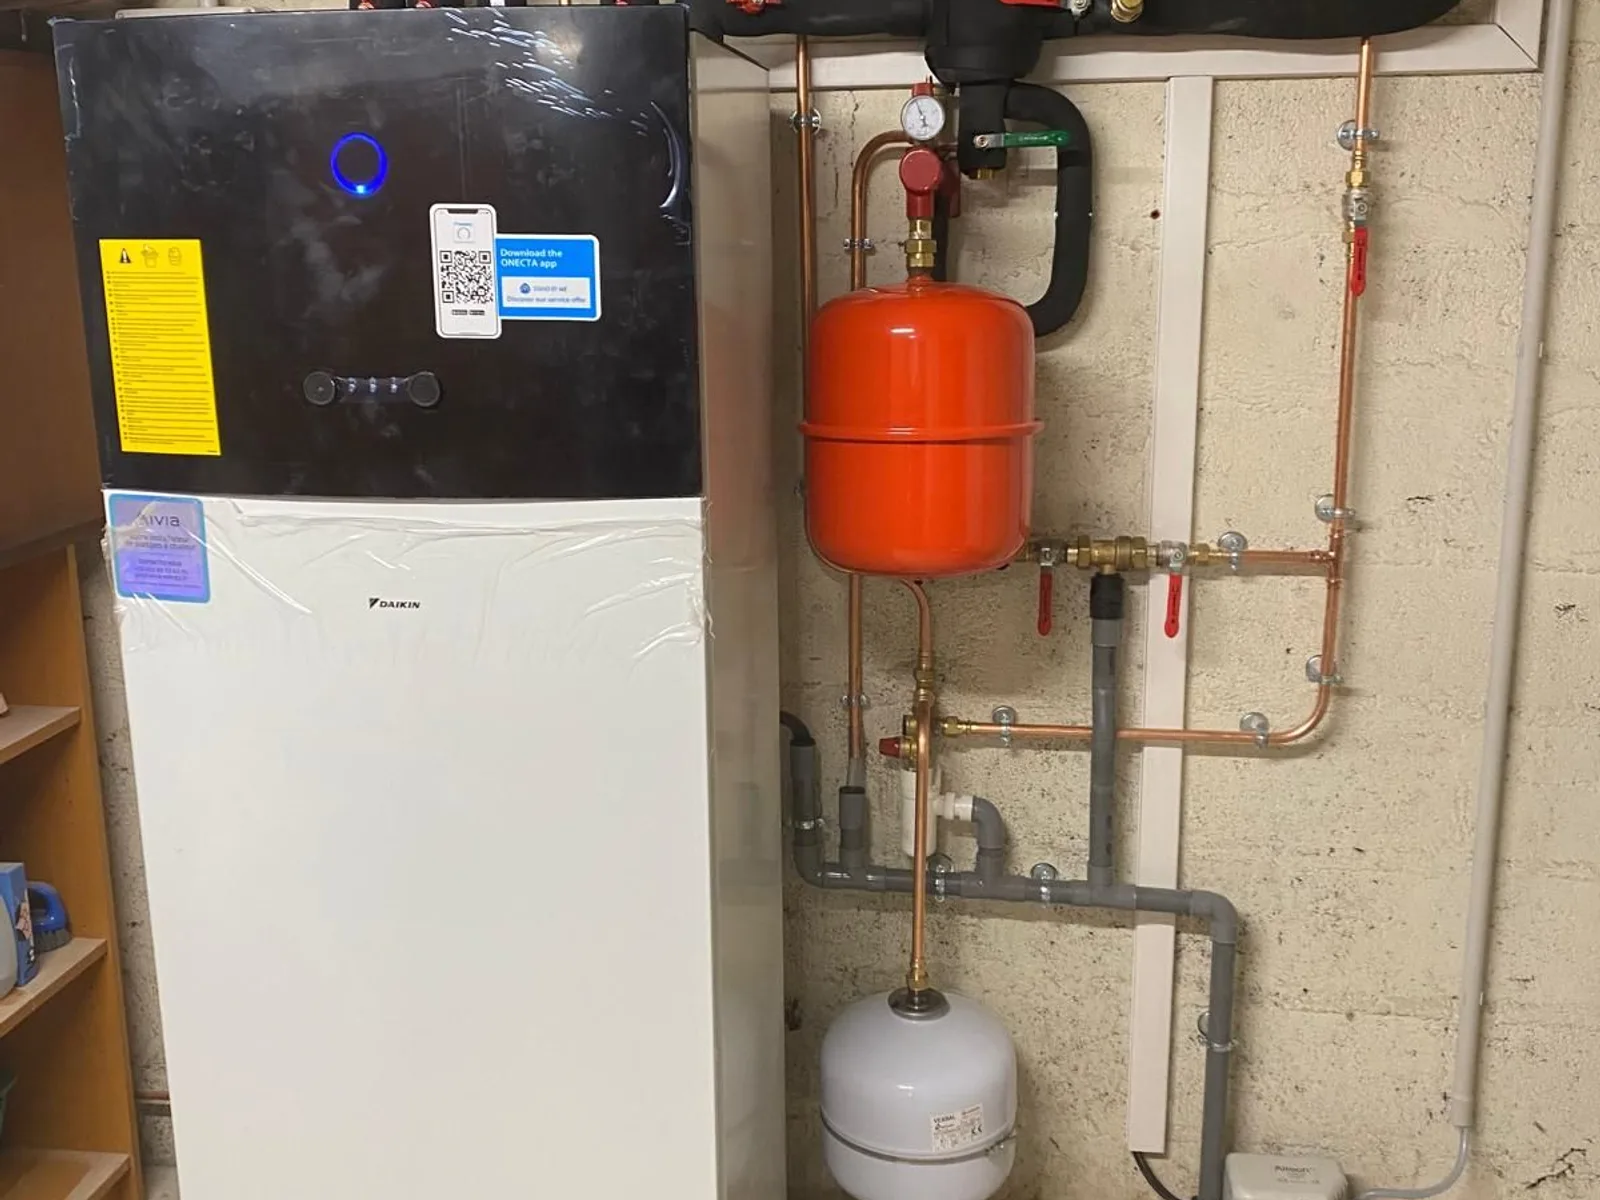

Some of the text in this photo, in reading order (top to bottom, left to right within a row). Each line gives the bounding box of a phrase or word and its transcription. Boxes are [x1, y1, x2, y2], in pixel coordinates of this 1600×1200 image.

[500, 248, 563, 258] Download the
[501, 258, 557, 269] ONECTA app
